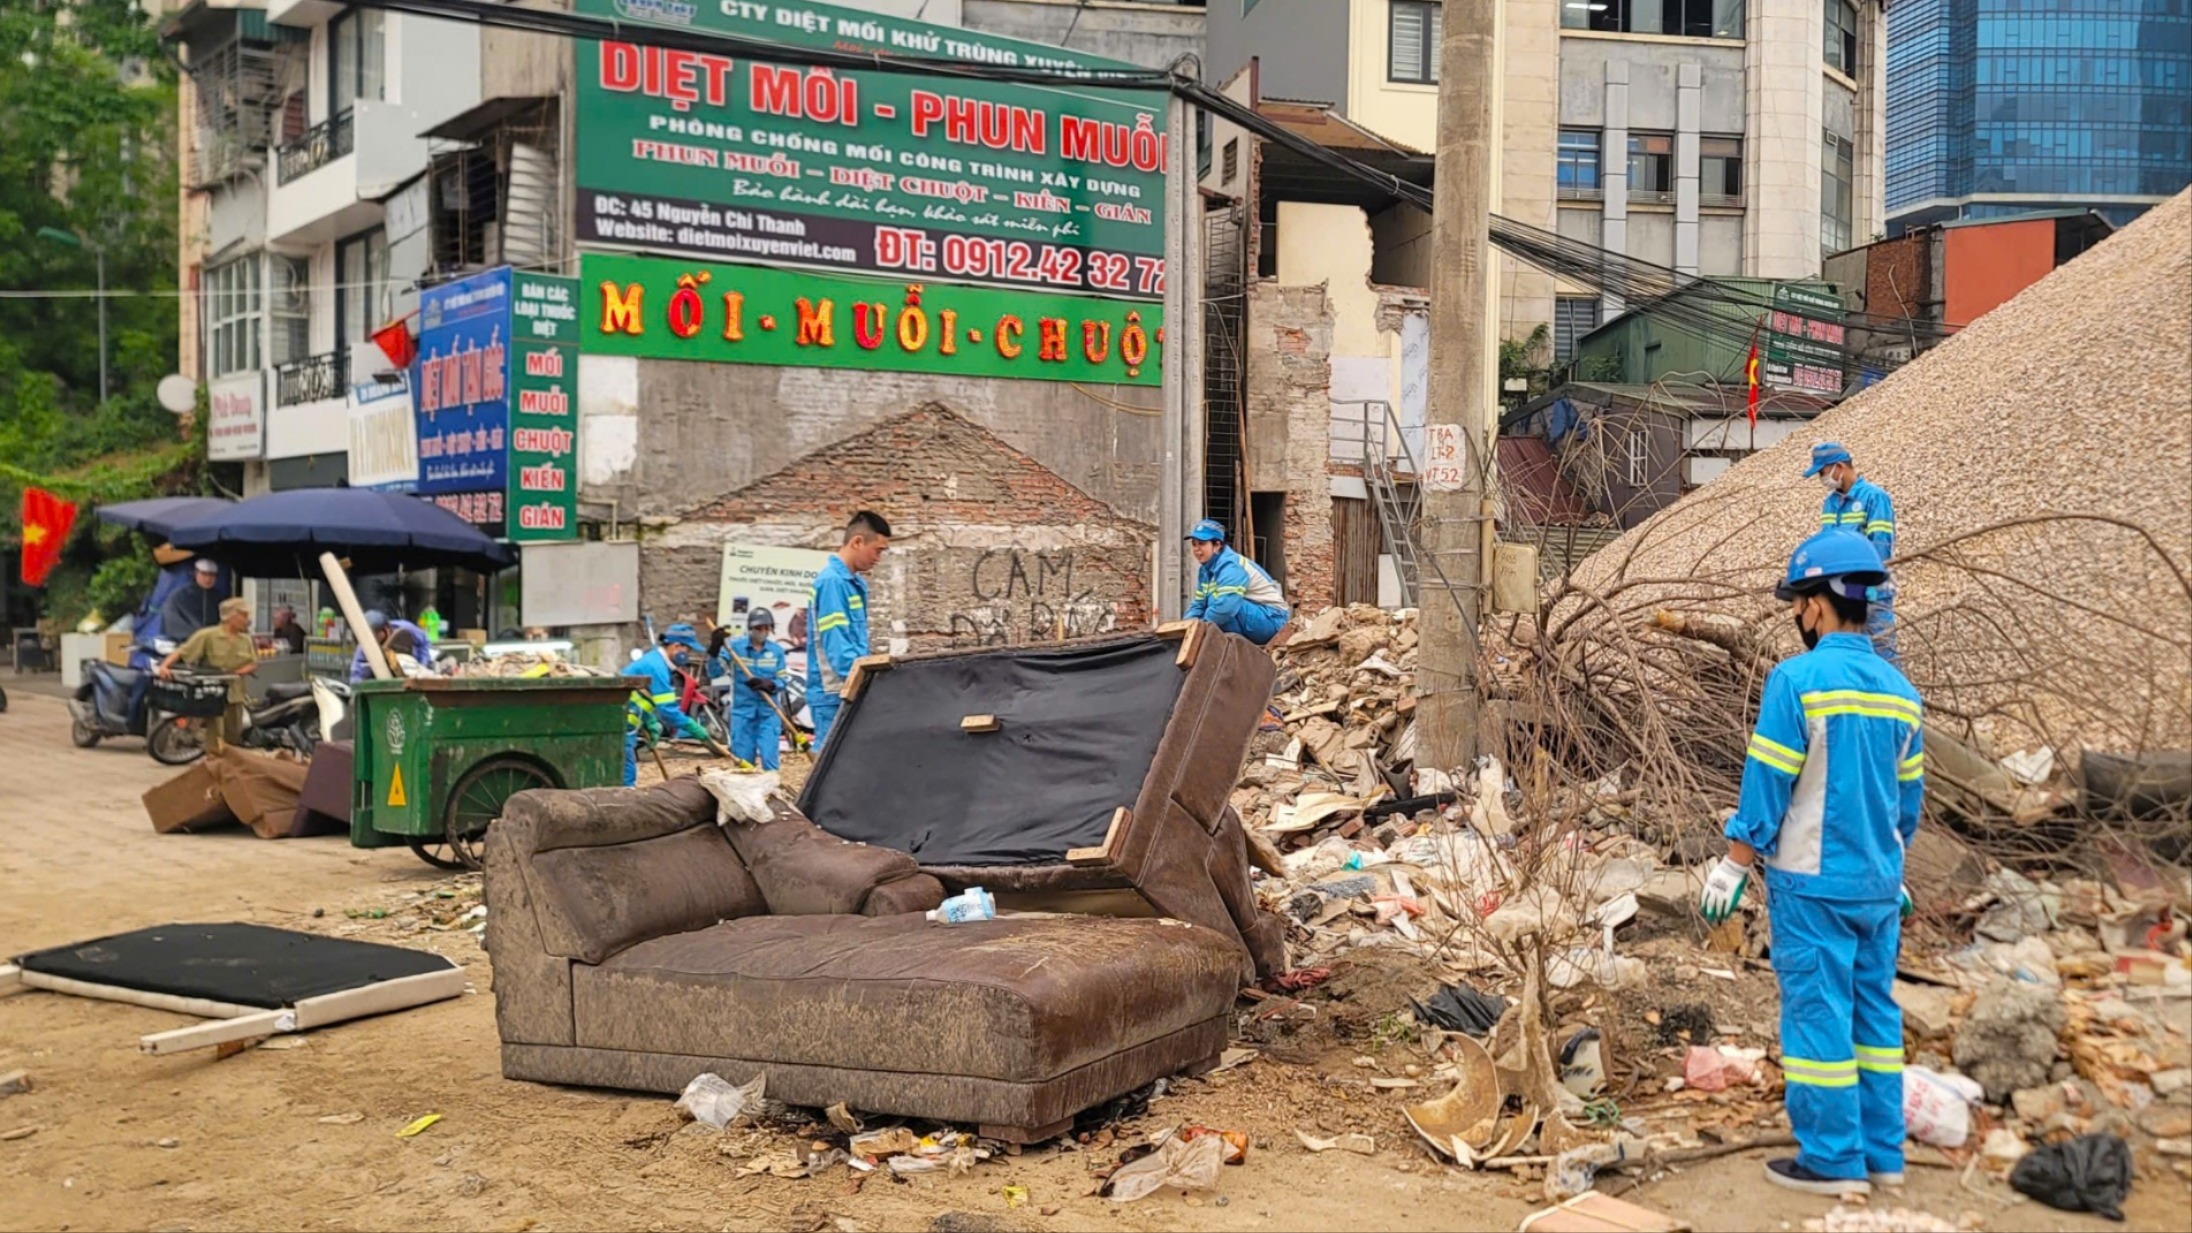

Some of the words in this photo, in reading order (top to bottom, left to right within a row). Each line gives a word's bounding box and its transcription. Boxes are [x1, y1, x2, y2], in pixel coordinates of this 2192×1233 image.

[720, 0, 769, 22] CTY
[775, 8, 831, 33] DIỆT
[837, 16, 885, 43] MỐI
[891, 28, 941, 53] KHỬ
[944, 39, 1018, 66] TRÙNG
[911, 89, 1046, 155] PHUN
[649, 115, 743, 142] PHÒNG
[751, 132, 838, 156] CHỐNG
[846, 144, 892, 163] MỐI
[899, 150, 962, 173] CÔNG
[969, 161, 1034, 183] TRÌNH
[1040, 170, 1080, 188] XÂY
[1086, 177, 1141, 199] DỰNG
[632, 138, 719, 168] PHUN
[723, 150, 801, 179] MUỖI
[829, 165, 895, 194] DIỆT
[899, 177, 988, 206] CHUỘT
[1013, 187, 1072, 214] KIẾN
[1095, 200, 1153, 225] GIÁN
[594, 195, 626, 216] ĐC:
[630, 201, 653, 219] 45
[657, 202, 722, 228] Nguyễn
[757, 217, 806, 237] Thanh
[732, 178, 774, 199] Bảo
[780, 185, 830, 207] hành
[835, 192, 869, 210] dài
[923, 203, 967, 224] khảo
[1003, 215, 1050, 232] miễn
[1052, 221, 1080, 238] phí
[595, 218, 675, 244] Website:
[677, 230, 857, 263] dietmoixuyenviet.com
[874, 225, 938, 272] ĐT:
[942, 235, 1082, 286] 0912.42
[1088, 251, 1130, 291] 32
[599, 270, 744, 342] MỐI
[795, 283, 958, 356] MUỖI
[994, 309, 1164, 378] CHUỘ
[525, 347, 563, 378] MỐI
[518, 385, 568, 416] MUỖI
[513, 426, 573, 459] CHUỘT
[520, 462, 565, 491] KIẾN
[520, 502, 565, 530] GIÁN
[804, 571, 819, 579] DO
